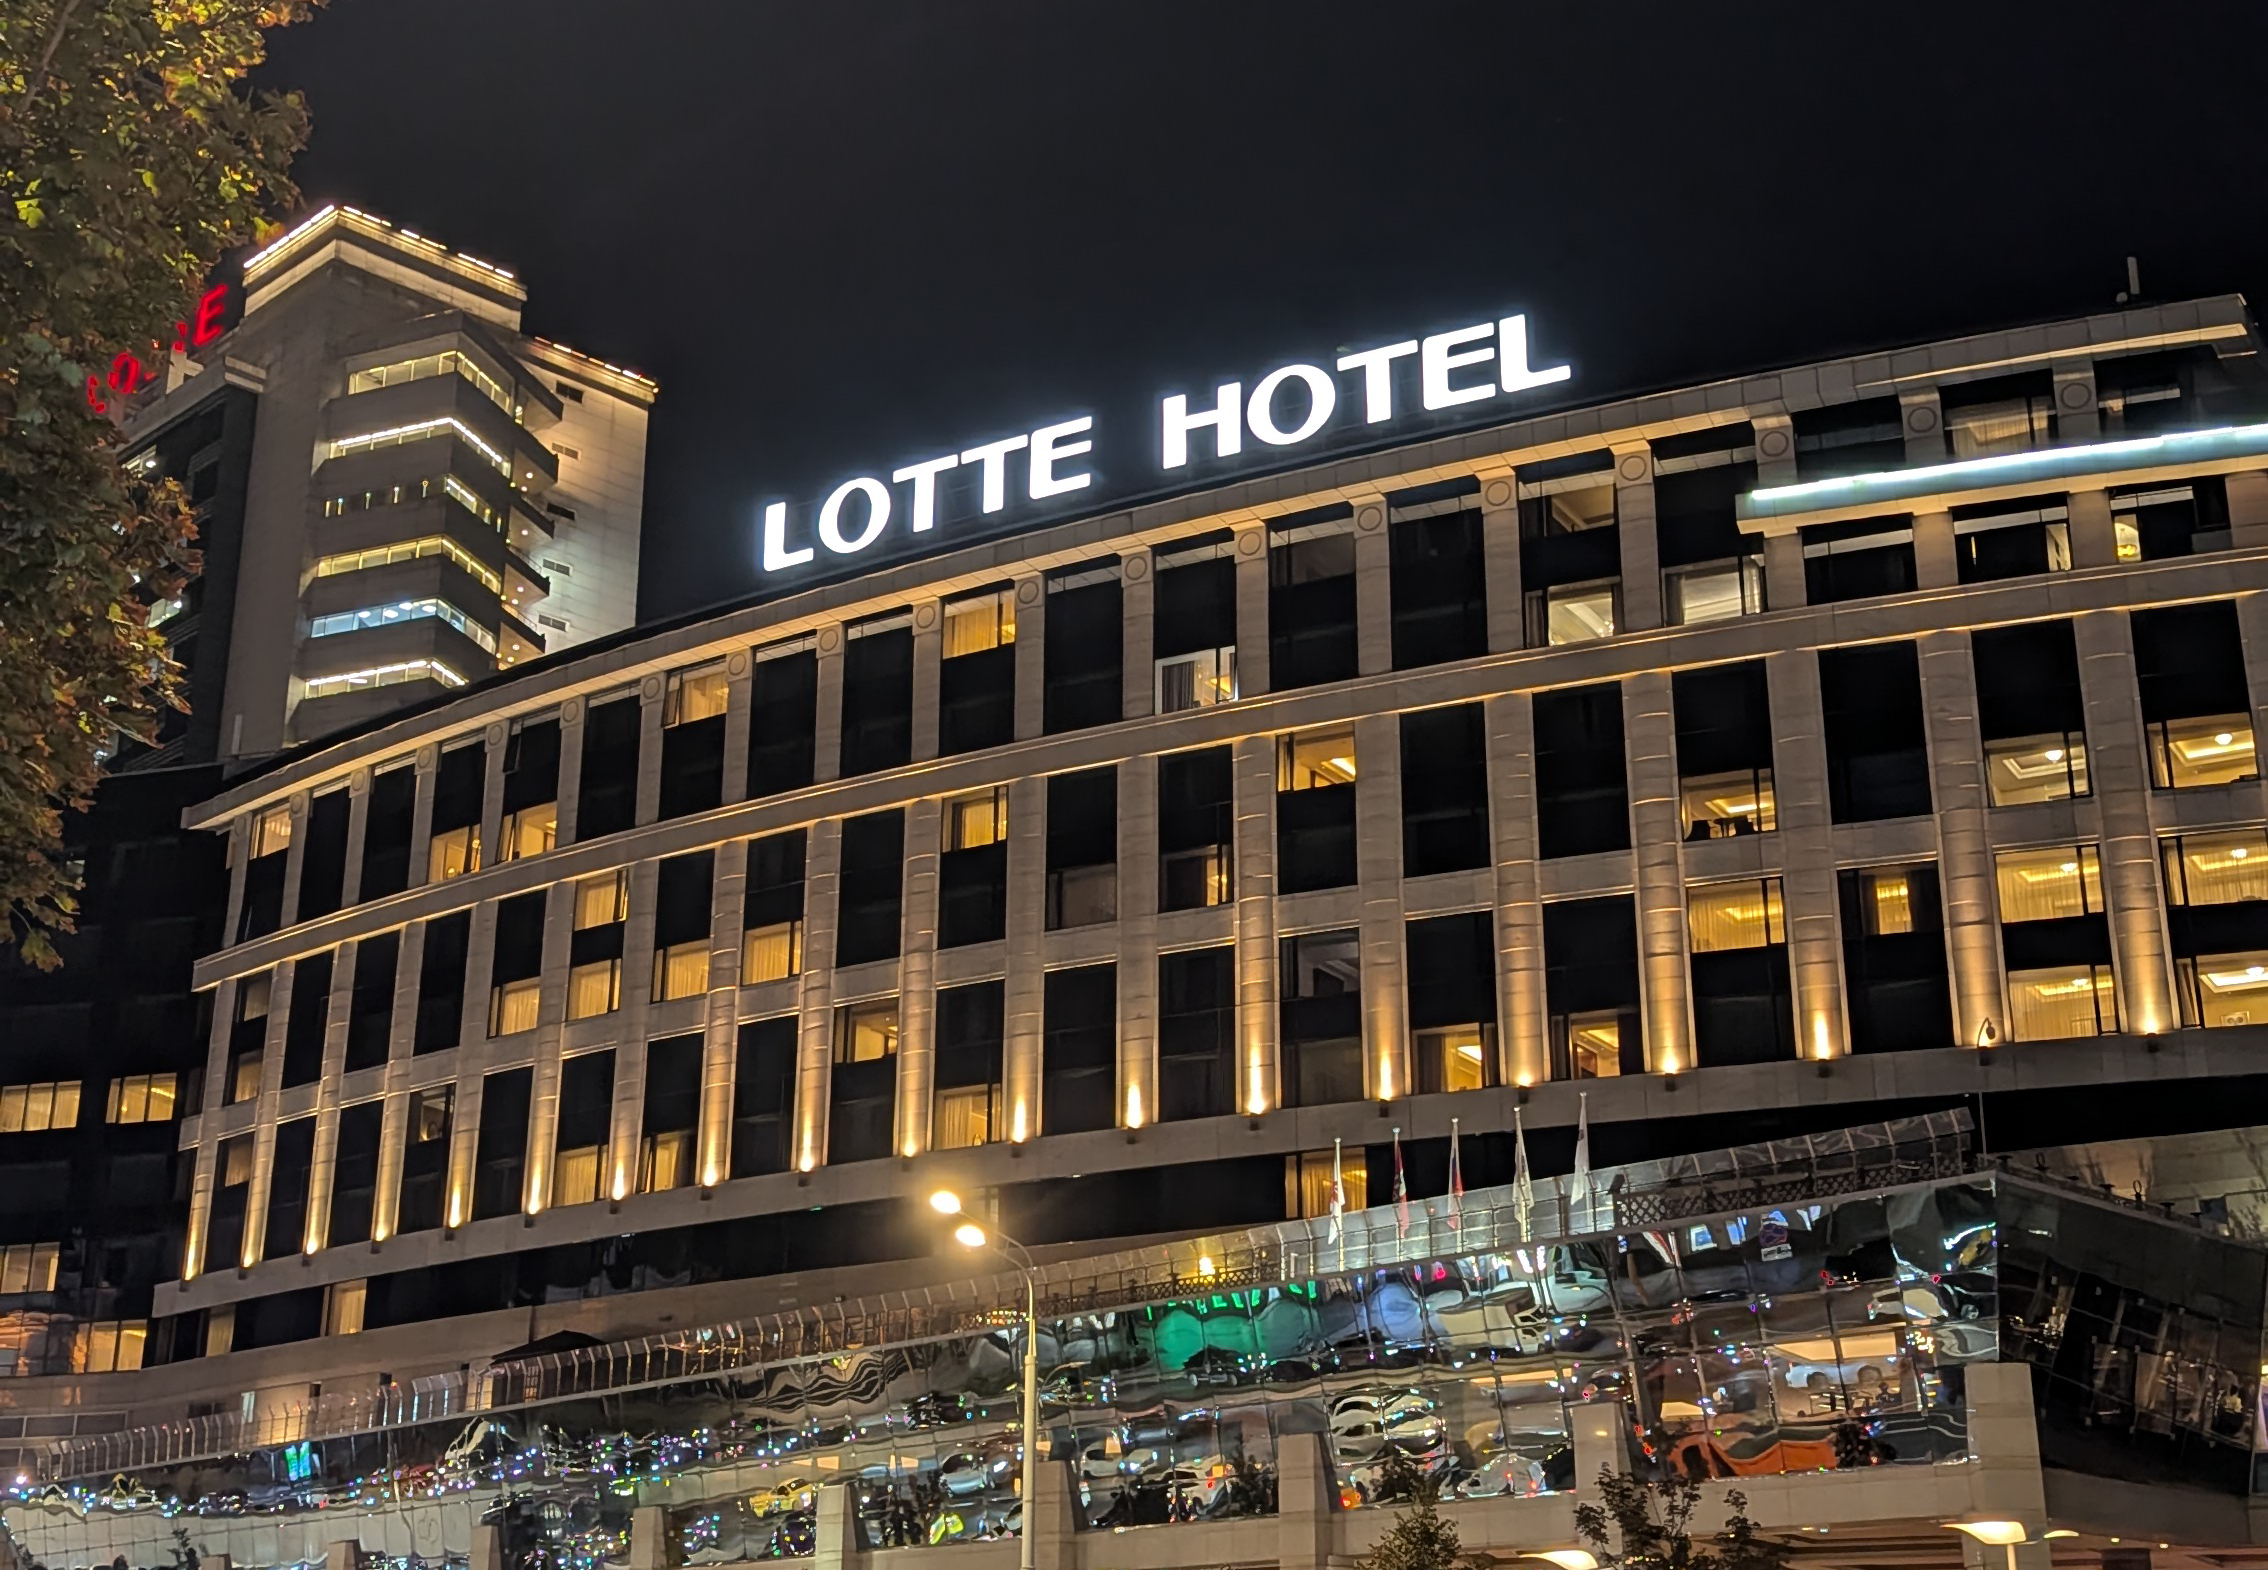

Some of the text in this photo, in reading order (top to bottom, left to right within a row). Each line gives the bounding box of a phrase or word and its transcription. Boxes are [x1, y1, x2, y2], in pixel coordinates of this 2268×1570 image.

[87, 284, 228, 414] LOE
[763, 313, 1572, 572] LOTTE HOTEL
